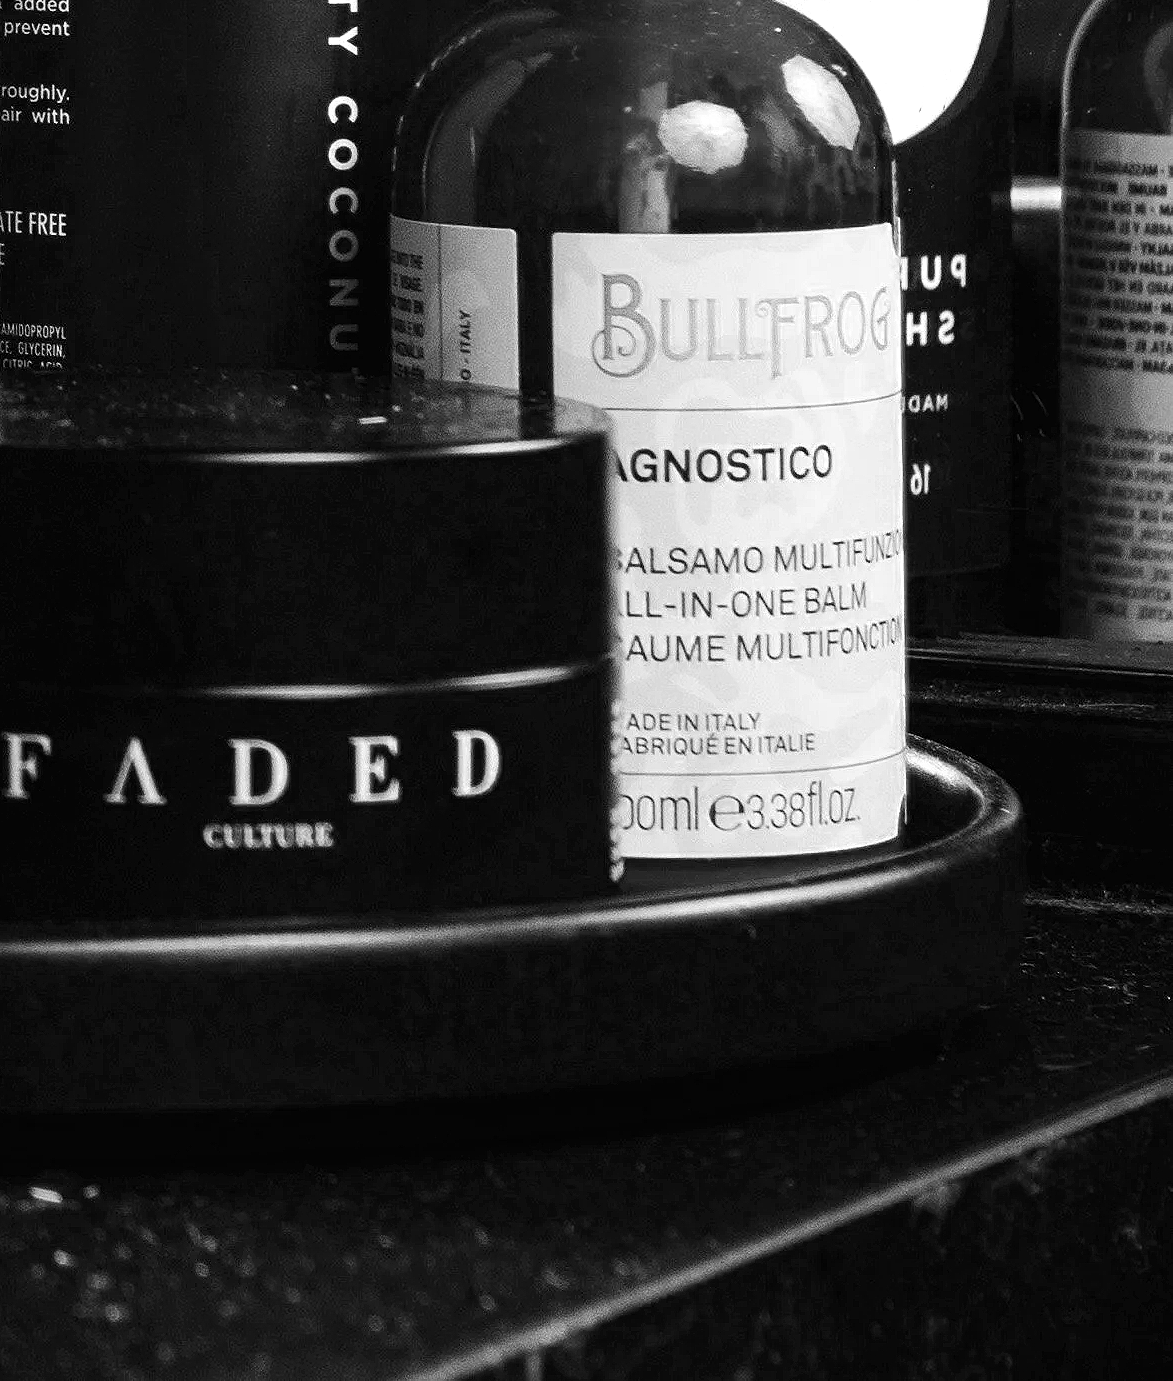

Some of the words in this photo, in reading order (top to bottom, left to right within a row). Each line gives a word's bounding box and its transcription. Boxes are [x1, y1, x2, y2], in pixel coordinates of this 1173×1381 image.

[4, 20, 70, 37] prevent
[32, 107, 70, 124] with
[29, 211, 67, 237] FREE
[459, 309, 472, 354] ITALY
[591, 273, 892, 379] BULLFROG
[618, 546, 765, 575] ALSAMO
[619, 589, 796, 618] LL-IN-ONE
[804, 582, 867, 614] BALM
[618, 633, 727, 662] AUME
[677, 713, 699, 732] IN
[705, 712, 761, 732] ITALY
[724, 736, 753, 755] EN
[757, 732, 816, 755] ITALIE
[202, 821, 335, 850] CULTURE
